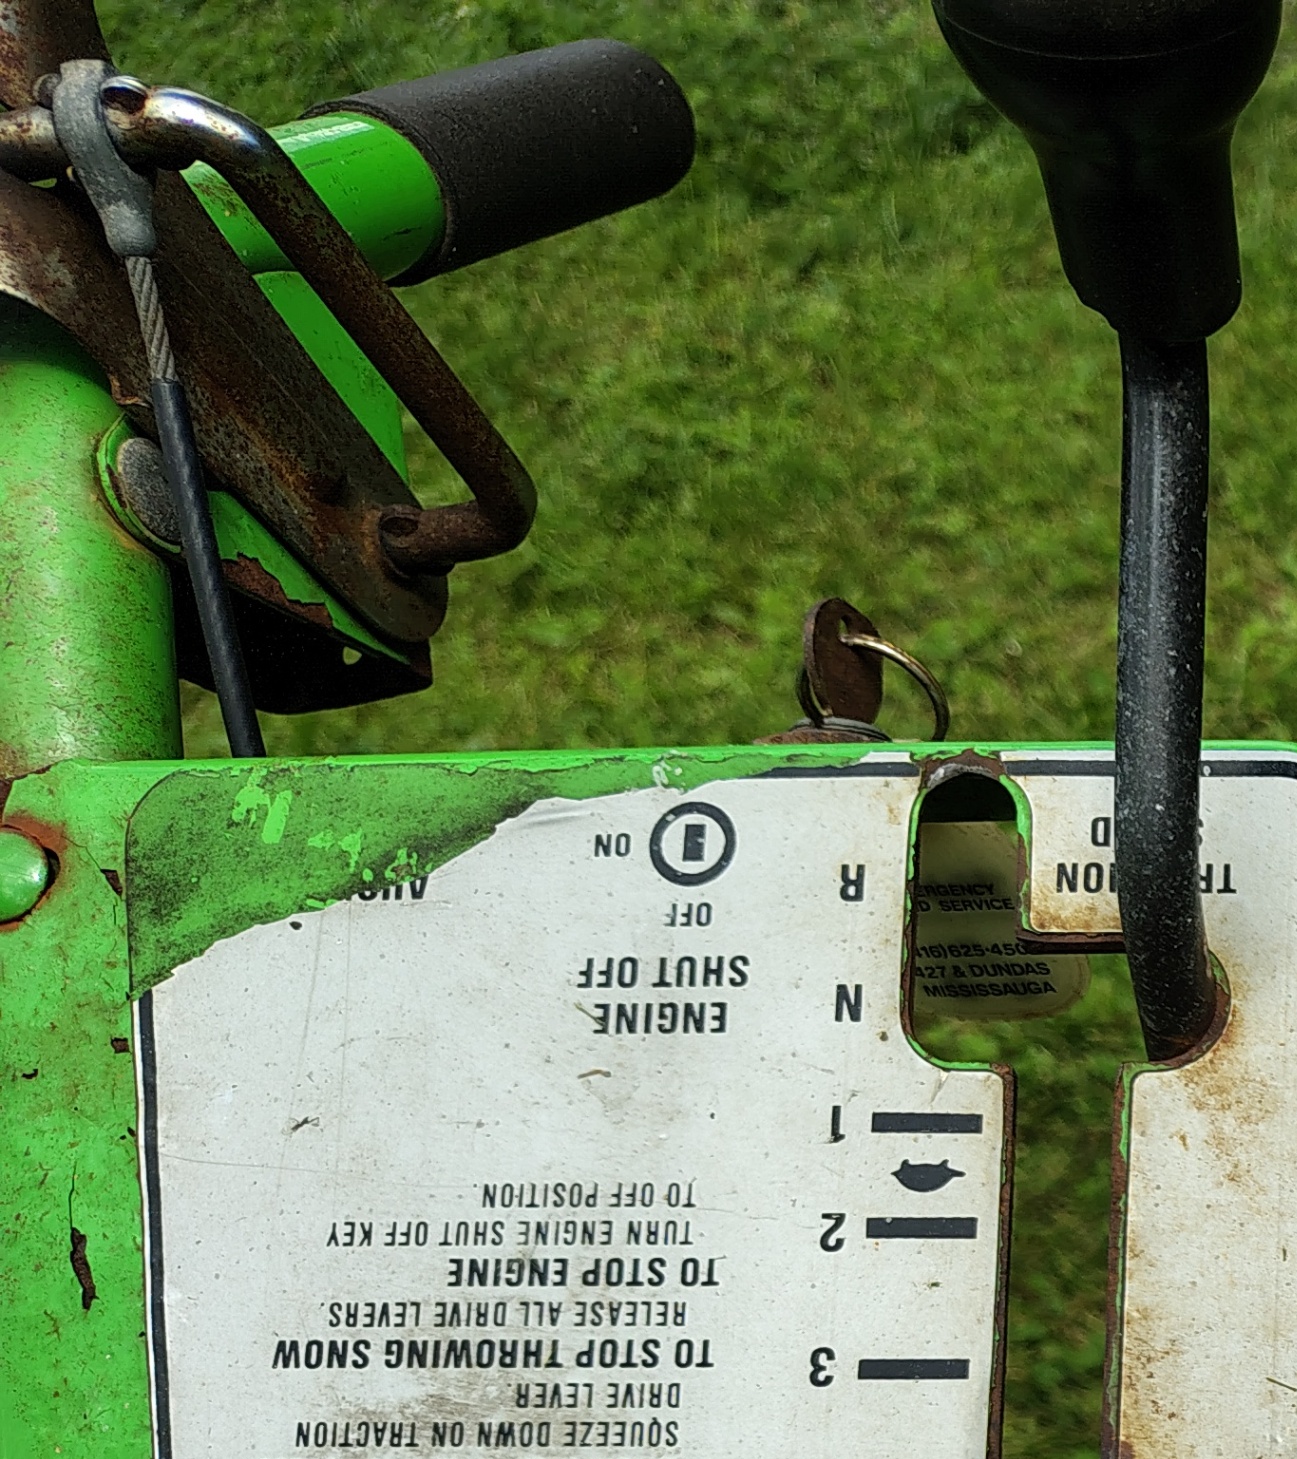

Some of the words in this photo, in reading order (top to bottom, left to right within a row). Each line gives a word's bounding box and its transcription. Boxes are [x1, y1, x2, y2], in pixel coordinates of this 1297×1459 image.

[594, 832, 631, 858] ON
[839, 863, 866, 902] R
[916, 884, 994, 898] ERGENCY
[1054, 862, 1238, 895] TRION
[664, 902, 713, 928] OFF
[939, 899, 1015, 912] SERVICE
[576, 956, 639, 989] OFF
[651, 955, 750, 988] SHUT
[953, 964, 967, 979] &
[969, 962, 1051, 978] DUNDAS
[834, 983, 863, 1023] N
[923, 981, 1057, 999] MISSISSAUGA
[588, 1001, 727, 1035] ENGINE
[829, 1105, 846, 1144] 1
[608, 1182, 655, 1208] OFF
[664, 1182, 696, 1208] TO
[326, 1221, 373, 1247] KEY
[383, 1221, 429, 1247] OFF
[438, 1220, 505, 1247] SHUT
[517, 1220, 613, 1246] ENGINE
[626, 1220, 693, 1246] TURN
[819, 1212, 846, 1253] 2
[447, 1257, 569, 1287] ENGINE
[581, 1257, 667, 1287] STOP
[680, 1257, 720, 1287] TO
[433, 1301, 507, 1328] DRIVE
[519, 1301, 563, 1327] ALL
[573, 1300, 687, 1327] RELEASE
[271, 1339, 371, 1370] SNOW
[384, 1338, 563, 1369] THROWING
[575, 1338, 661, 1369] STOP
[674, 1338, 714, 1369] TO
[809, 1346, 836, 1388] 3
[606, 1382, 681, 1409] DRIVE
[295, 1420, 420, 1448] TRACTION
[431, 1421, 465, 1448] ON
[477, 1421, 551, 1448] DOWN
[562, 1416, 679, 1448] SQUEEZE
